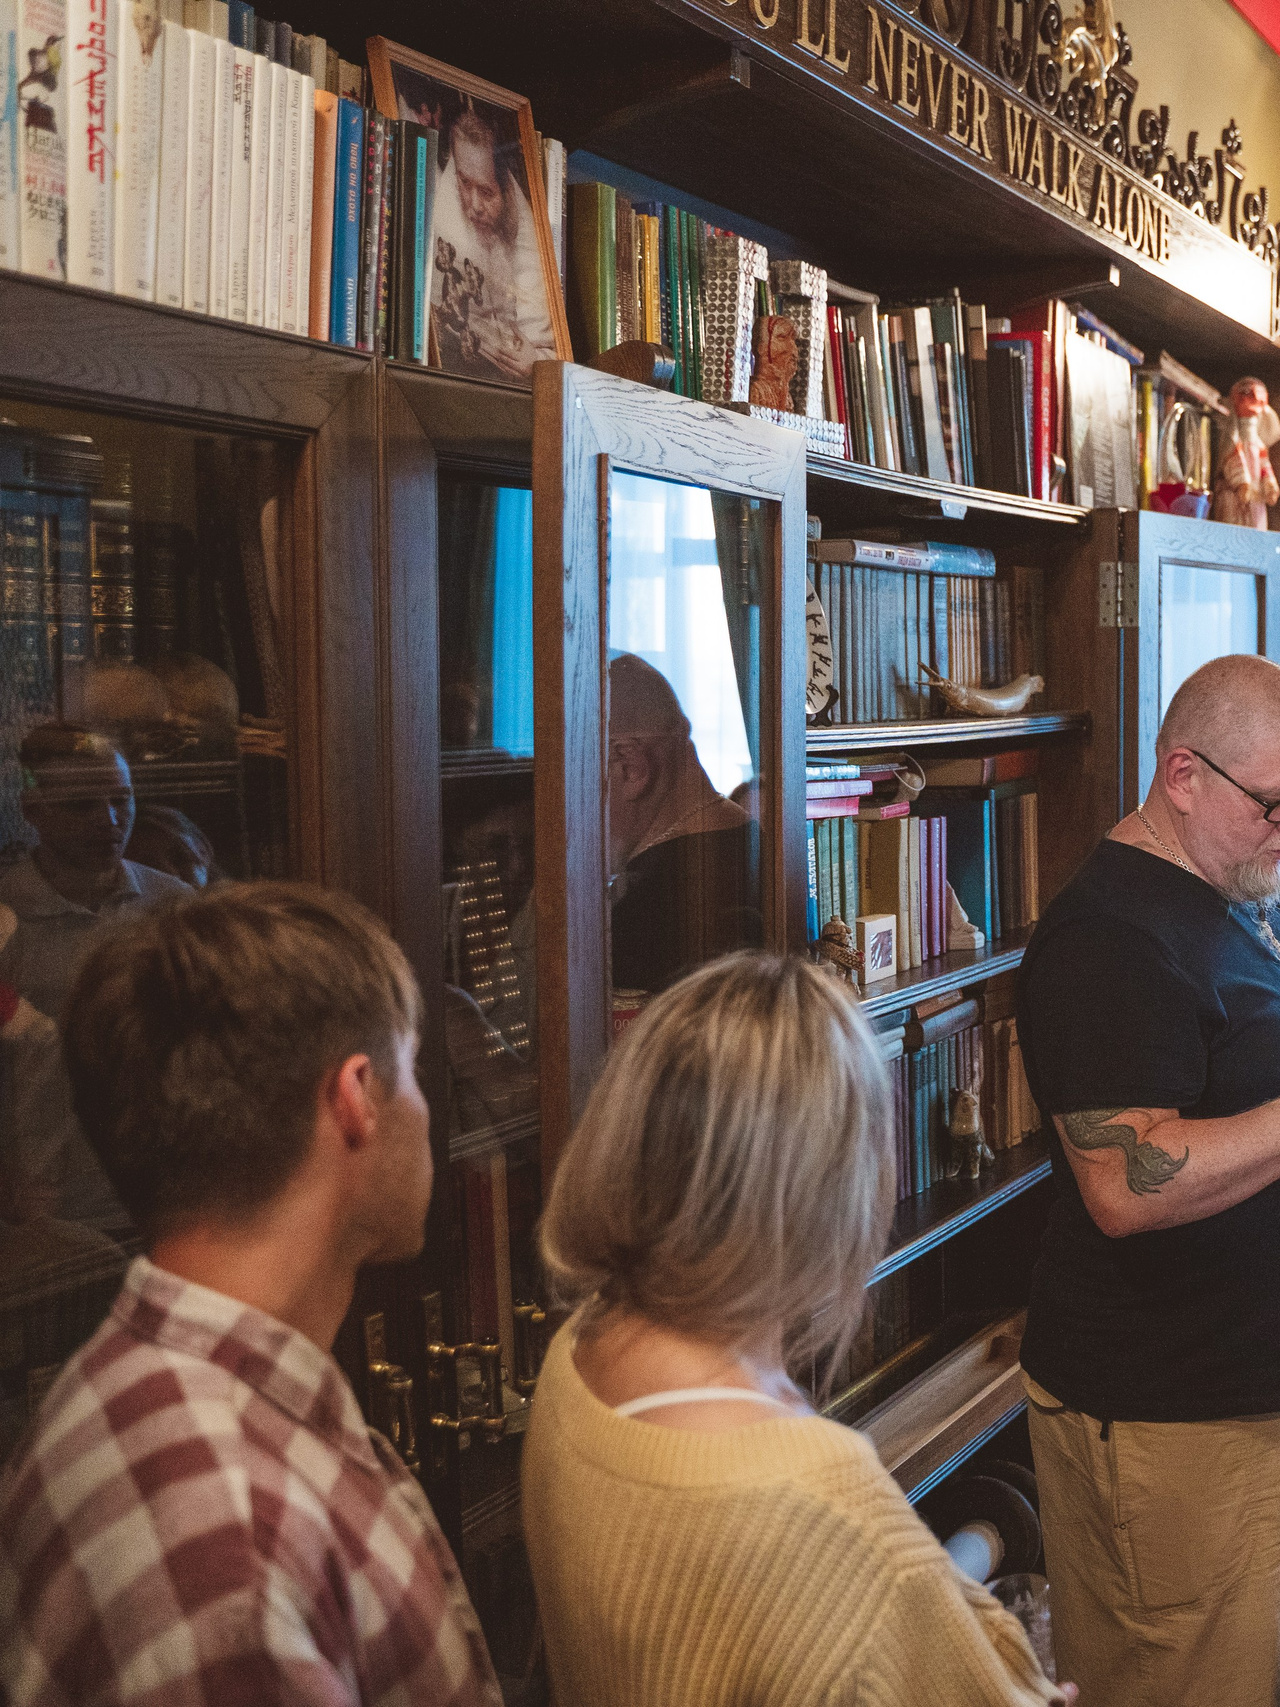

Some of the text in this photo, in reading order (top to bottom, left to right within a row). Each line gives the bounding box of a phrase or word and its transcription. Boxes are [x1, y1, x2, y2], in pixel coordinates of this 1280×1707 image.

[291, 78, 300, 109] Китай
[289, 120, 299, 167] шлюпкой
[349, 142, 359, 169] овец
[866, 5, 994, 162] NEVER
[1004, 99, 1087, 217] WALK
[1093, 164, 1172, 266] ALONE
[288, 170, 298, 224] Медленной
[286, 234, 295, 278] Мураками
[285, 279, 294, 309] Харуки
[346, 277, 355, 342] МУРАКАМИ
